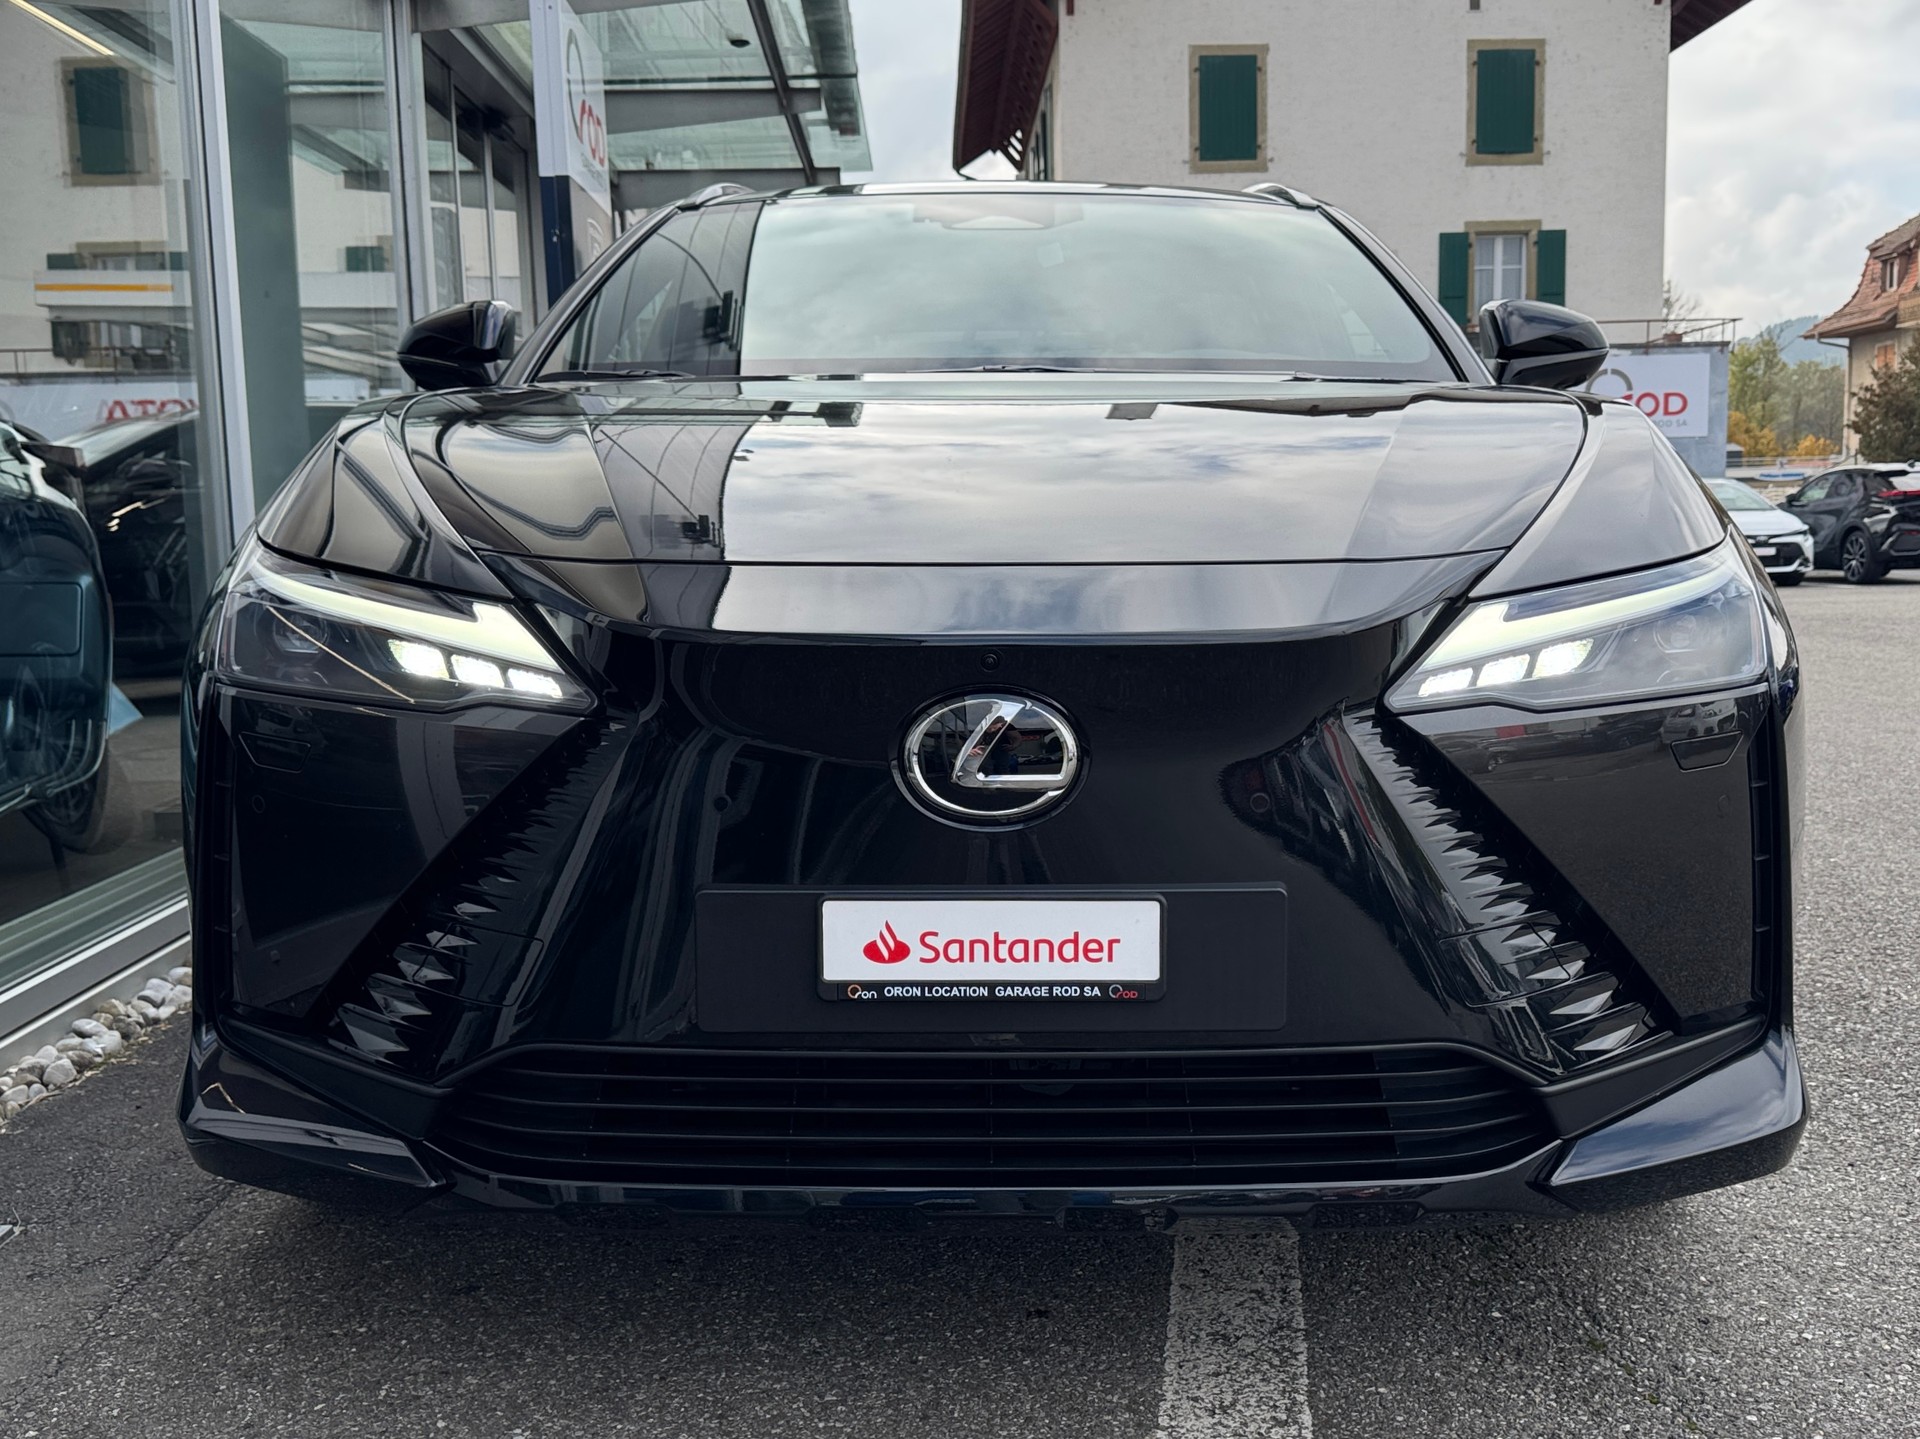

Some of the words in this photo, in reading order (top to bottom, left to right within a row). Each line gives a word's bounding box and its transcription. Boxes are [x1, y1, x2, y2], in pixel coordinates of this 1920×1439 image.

[919, 931, 1121, 963] Santander
[884, 986, 921, 997] ORON
[924, 986, 988, 997] LOCATION
[995, 986, 1049, 997] GARAGE
[1052, 986, 1081, 997] ROD
[1083, 986, 1101, 997] SA
